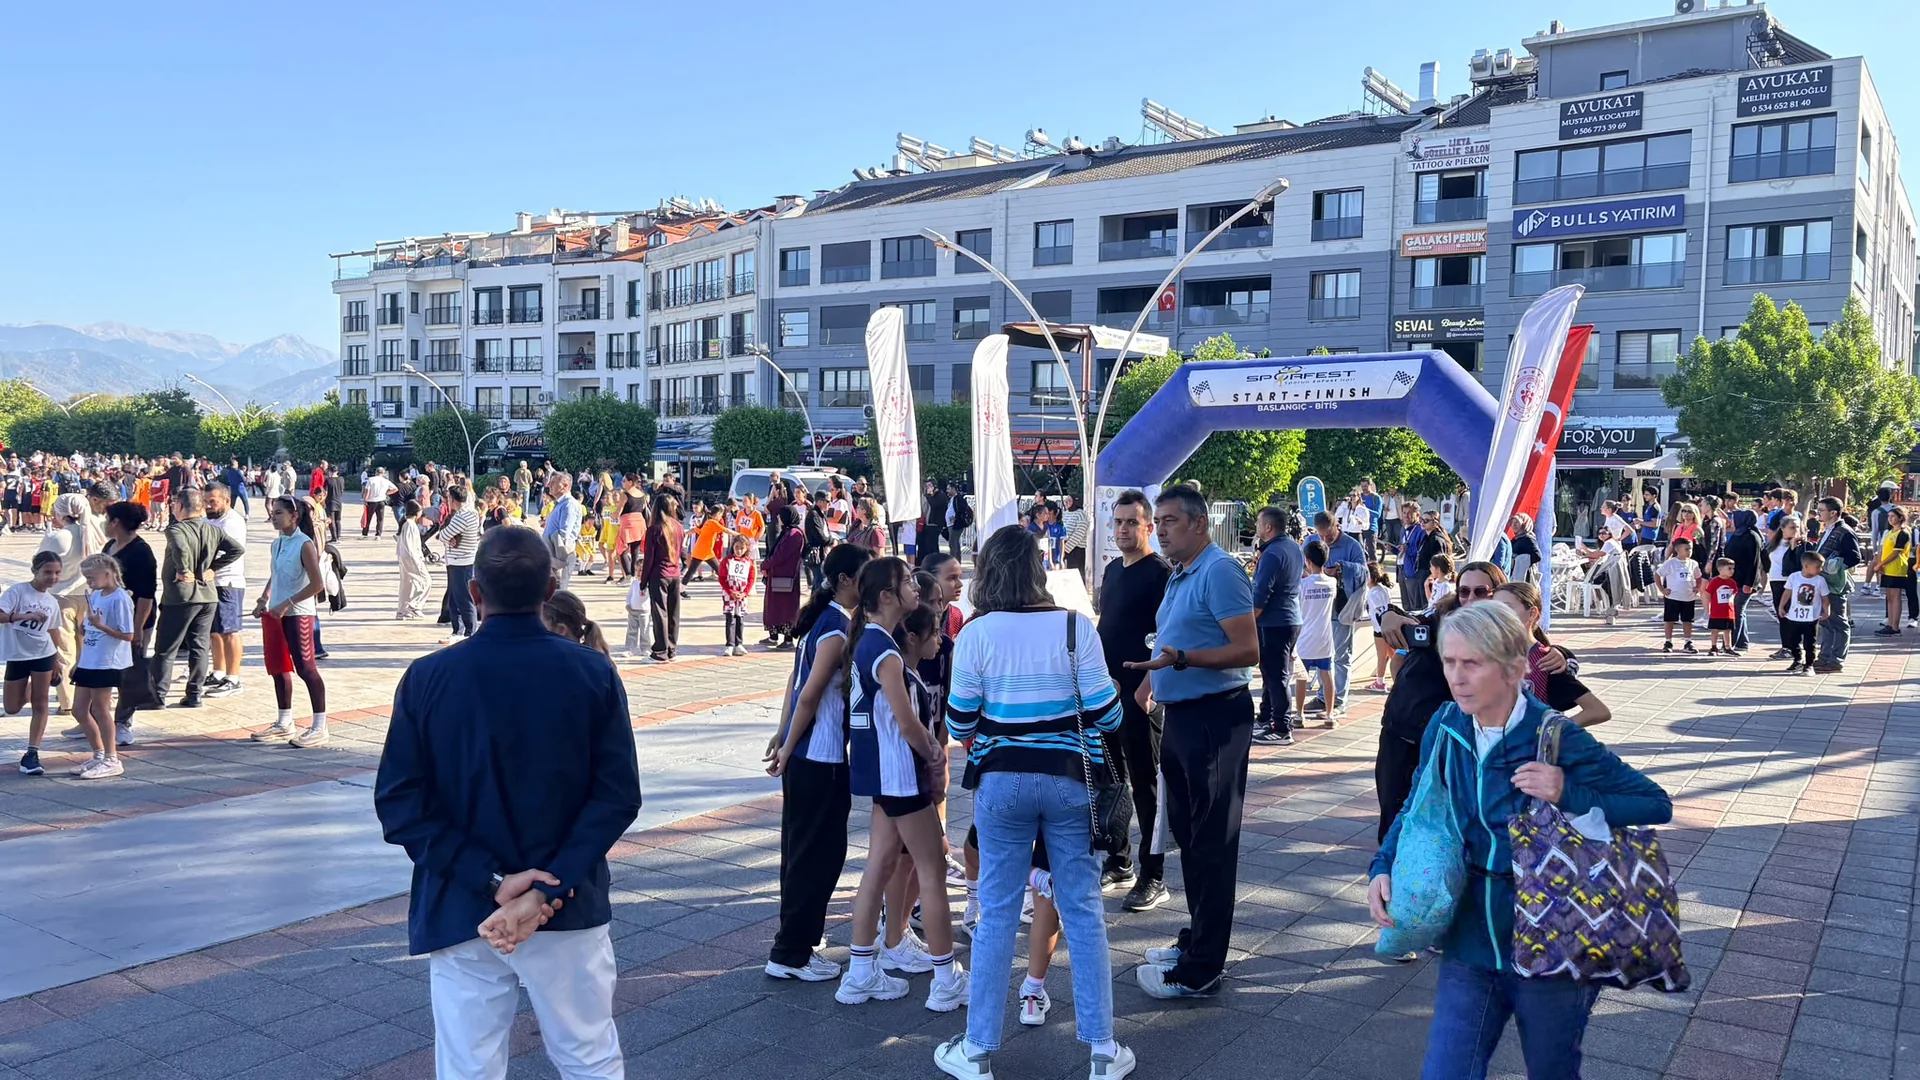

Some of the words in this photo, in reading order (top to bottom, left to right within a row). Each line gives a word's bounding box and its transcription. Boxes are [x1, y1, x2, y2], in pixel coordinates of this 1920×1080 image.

[1745, 69, 1823, 91] AVUKAT
[1741, 93, 1770, 103] MELİH
[1771, 86, 1828, 99] TOPALOĞLU
[1567, 95, 1635, 116] AVUKAT
[1758, 104, 1772, 112] 534
[1774, 102, 1788, 110] 652
[1561, 114, 1598, 127] MUSTAFA
[1598, 109, 1641, 121] KOCATEPE
[1573, 128, 1578, 136] 0
[1579, 126, 1592, 135] 506
[1593, 124, 1606, 133] 773
[1607, 123, 1617, 131] 39
[1618, 122, 1627, 130] 69
[1424, 147, 1461, 158] GÜZELLİK
[1464, 144, 1490, 155] SALON
[1411, 160, 1444, 170] TATTOO
[1445, 159, 1453, 167] &
[1454, 155, 1490, 166] PIERCIN
[1551, 211, 1608, 228] BULLS
[1611, 204, 1676, 222] YATIRIM
[1405, 232, 1452, 247] GALAKSİ
[1453, 231, 1486, 243] PERUK
[1394, 319, 1435, 332] SEVAL
[1441, 318, 1466, 328] Beauty
[1257, 402, 1307, 412] BAŞLANGIÇ
[1315, 400, 1338, 410] BİTİŞ
[1563, 430, 1595, 444] FOR
[1600, 429, 1636, 445] YOU
[1578, 444, 1618, 458] Boutique
[1636, 469, 1662, 477] BAKKU
[740, 517, 751, 527] 347
[734, 563, 744, 575] 82
[1793, 607, 1810, 619] 137
